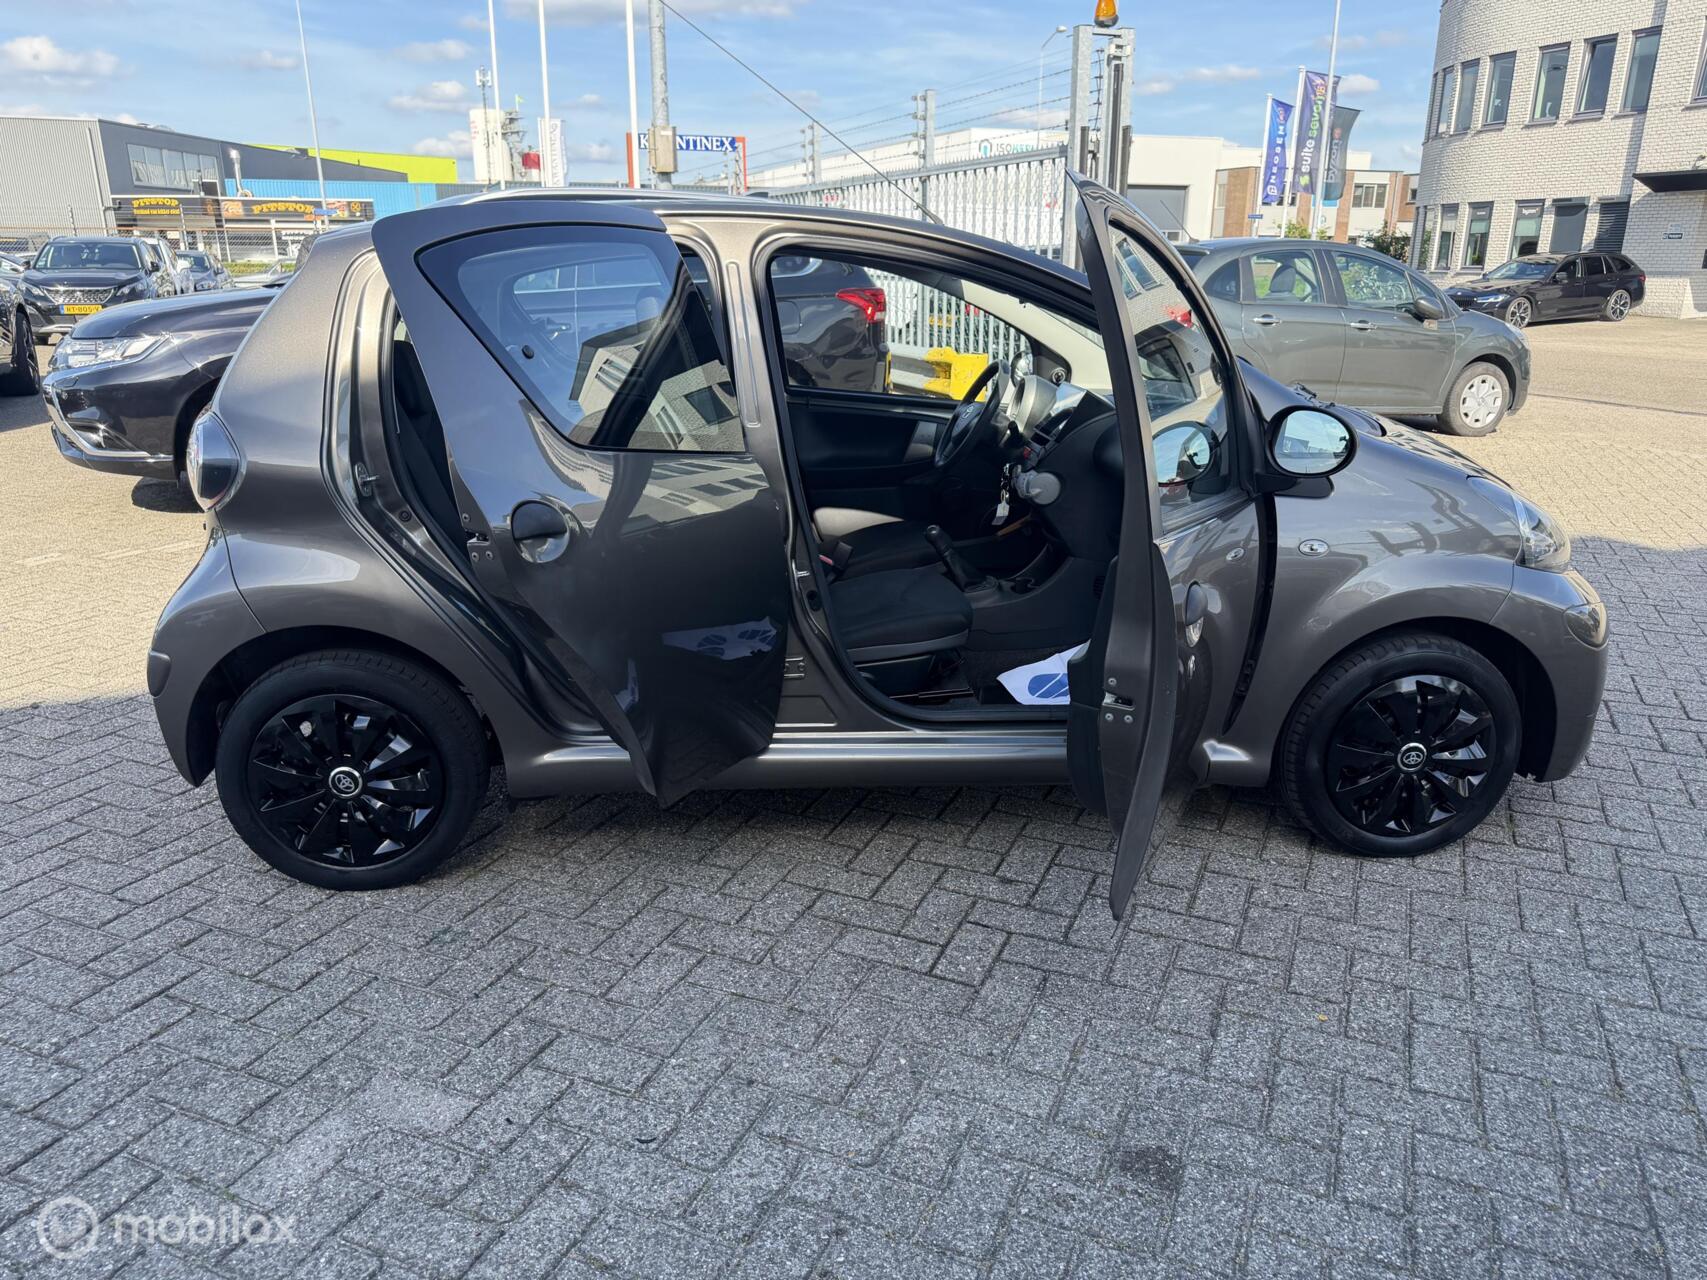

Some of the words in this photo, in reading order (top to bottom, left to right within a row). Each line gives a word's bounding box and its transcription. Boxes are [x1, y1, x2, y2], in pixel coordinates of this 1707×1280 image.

[640, 134, 734, 153] KNTINEX
[1301, 138, 1315, 173] suite
[132, 197, 179, 208] PITSTOP
[252, 202, 315, 214] PITSTOP
